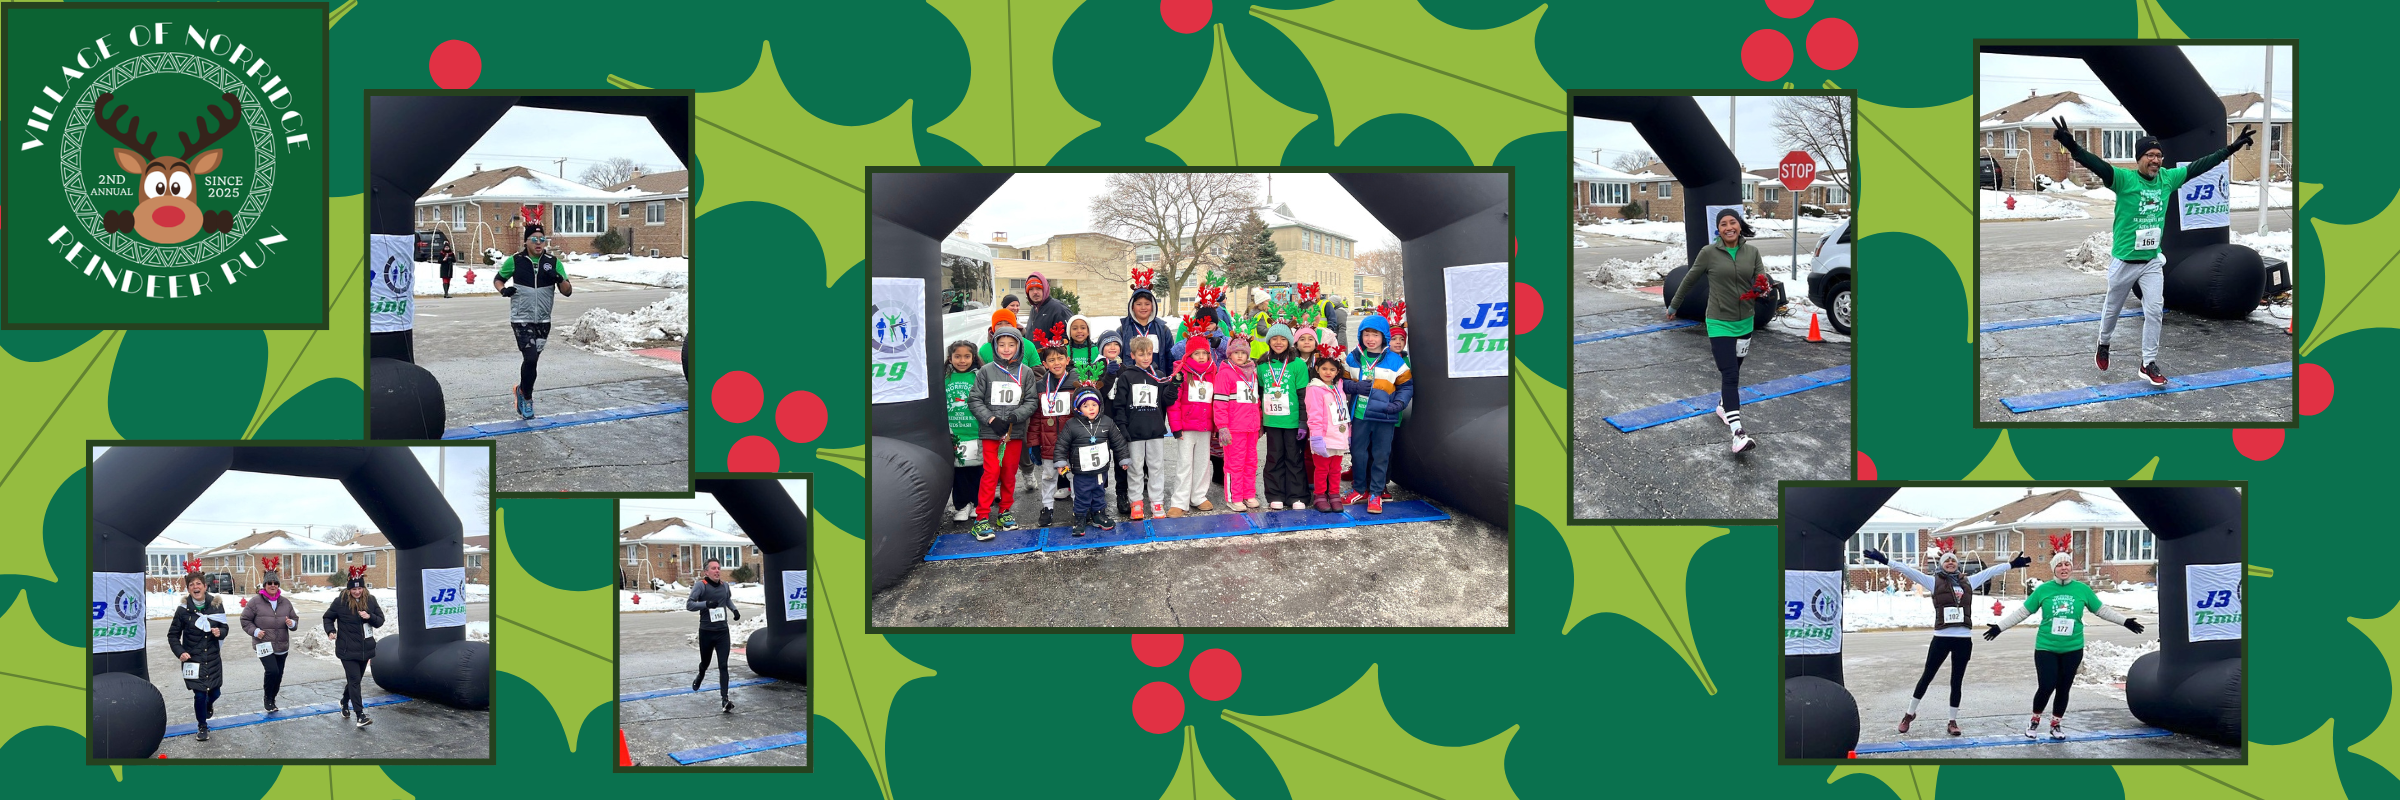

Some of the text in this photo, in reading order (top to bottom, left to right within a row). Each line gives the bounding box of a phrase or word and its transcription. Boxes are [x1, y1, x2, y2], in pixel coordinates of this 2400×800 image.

[1781, 163, 1814, 178] STOP
[2186, 184, 2215, 201] J3
[2142, 238, 2155, 247] 166
[370, 296, 407, 316] ing
[1460, 302, 1508, 330] J3
[999, 389, 1014, 403] 10
[1139, 390, 1152, 404] 21
[1269, 403, 1283, 412] 135
[1090, 452, 1101, 467] 5
[431, 588, 456, 603] J3
[2196, 590, 2232, 609] J3
[1785, 601, 1804, 620] 3
[2195, 610, 2241, 626] Timi
